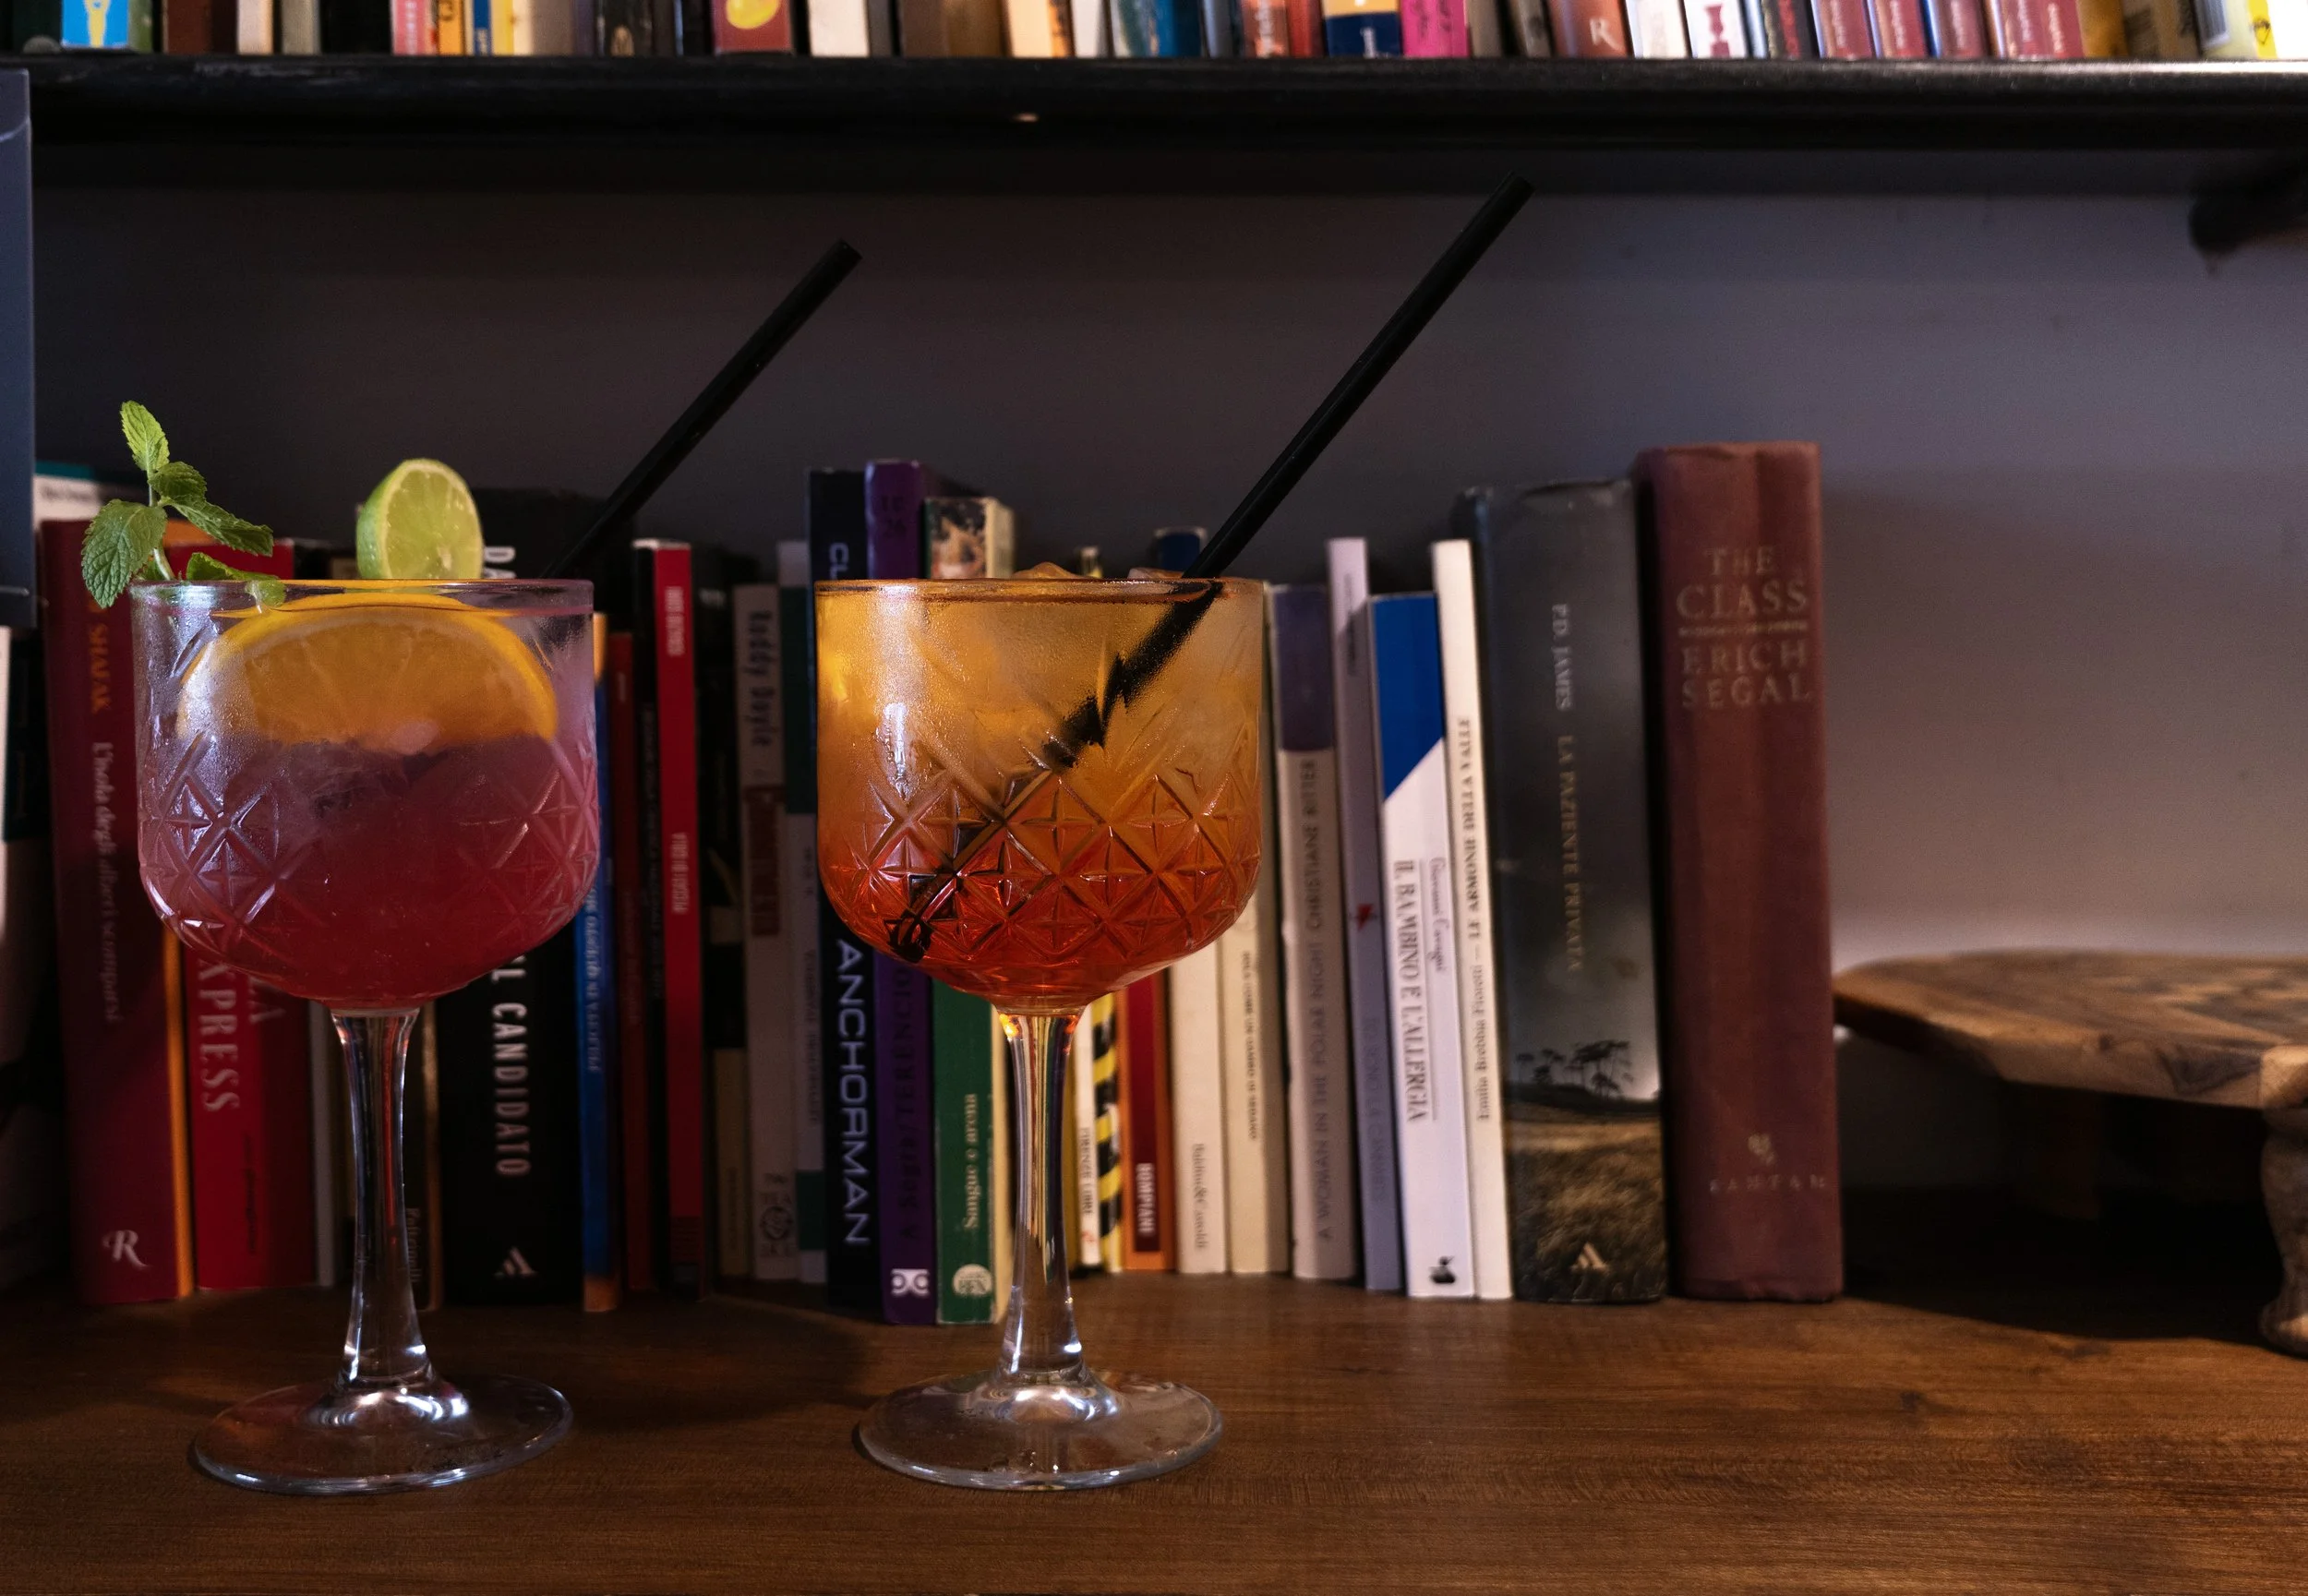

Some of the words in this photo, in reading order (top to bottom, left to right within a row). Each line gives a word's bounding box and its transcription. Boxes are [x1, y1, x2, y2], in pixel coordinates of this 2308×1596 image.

[1704, 546, 1774, 575] THE
[1676, 579, 1809, 620] CLASS
[745, 610, 775, 676] Roddy
[1682, 639, 1807, 676] ERICH
[1554, 646, 1573, 712] JAMES
[1682, 672, 1813, 710] SEGAL
[746, 687, 776, 747] Doyle
[1457, 719, 1472, 771] VALLE
[1557, 736, 1574, 766] LA
[1300, 760, 1318, 816] RITTER
[1460, 775, 1474, 831] DELLA
[93, 806, 117, 855] degli
[1559, 770, 1580, 875] PAZIENTE
[1303, 825, 1324, 930] CHRISTIANE
[1395, 859, 1414, 879] IL
[1462, 838, 1479, 912] ARMONIE
[1395, 883, 1420, 981] BAMBINO
[1563, 882, 1582, 973] PRIVATA
[490, 954, 527, 984] L
[1308, 942, 1326, 998] NIGHT
[1400, 986, 1420, 1000] E
[197, 957, 240, 1112] XPRESS
[1309, 1006, 1328, 1066] POLAR
[490, 1002, 532, 1179] CANDIDATO
[1312, 1076, 1328, 1105] THE
[1400, 1004, 1429, 1122] L'ALLERGIA
[835, 939, 871, 1245] ANCHORMAN
[963, 1093, 979, 1145] arena
[1314, 1111, 1329, 1132] IN
[965, 1149, 979, 1161] e
[1077, 1127, 1091, 1179] FIRENZE
[1315, 1140, 1331, 1218] WOMAN
[961, 1165, 980, 1230] Sangue
[1136, 1162, 1156, 1236] BOMPIANI
[101, 1229, 154, 1271] R
[1318, 1226, 1333, 1242] A
